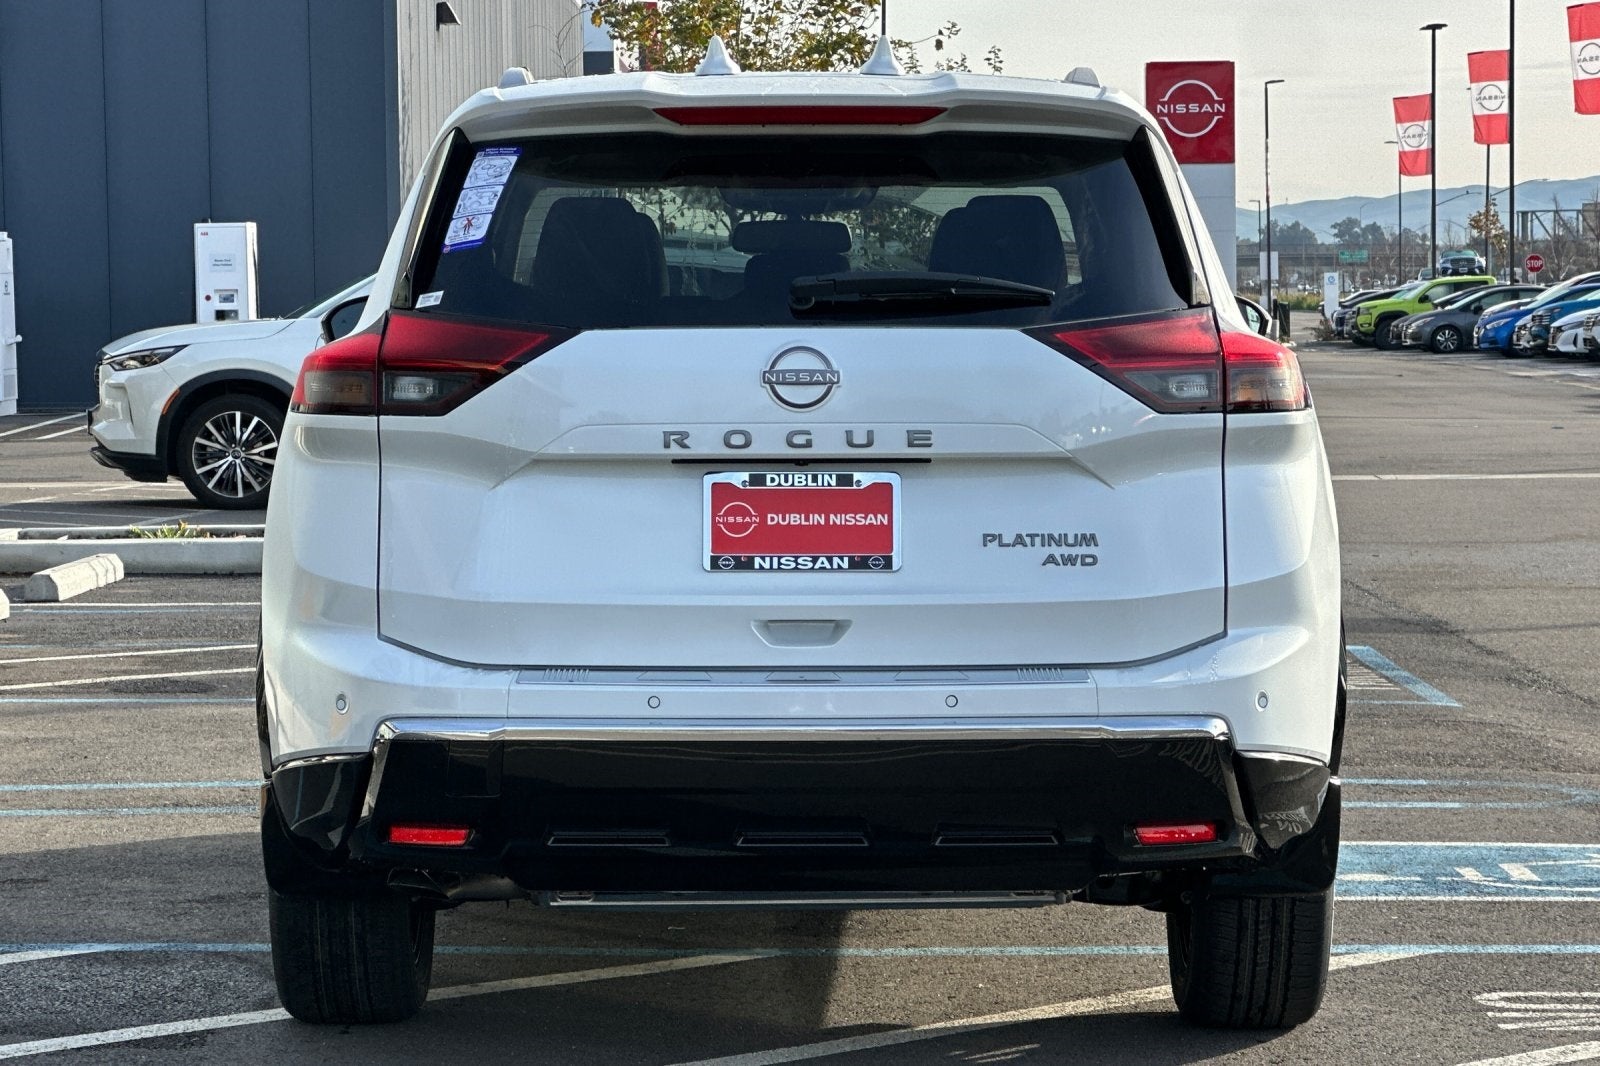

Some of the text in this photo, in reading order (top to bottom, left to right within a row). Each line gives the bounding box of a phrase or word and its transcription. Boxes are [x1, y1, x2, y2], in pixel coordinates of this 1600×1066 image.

[1156, 103, 1226, 114] NISSAN
[1526, 259, 1543, 268] STOP
[764, 372, 839, 383] NISSAN
[662, 429, 934, 449] ROGUE
[765, 473, 837, 487] DUBLIN
[767, 513, 889, 526] DUBLIN NISSAN
[982, 533, 1099, 548] PLATINUM
[753, 556, 849, 570] NISSAN
[1041, 553, 1099, 567] AWD
